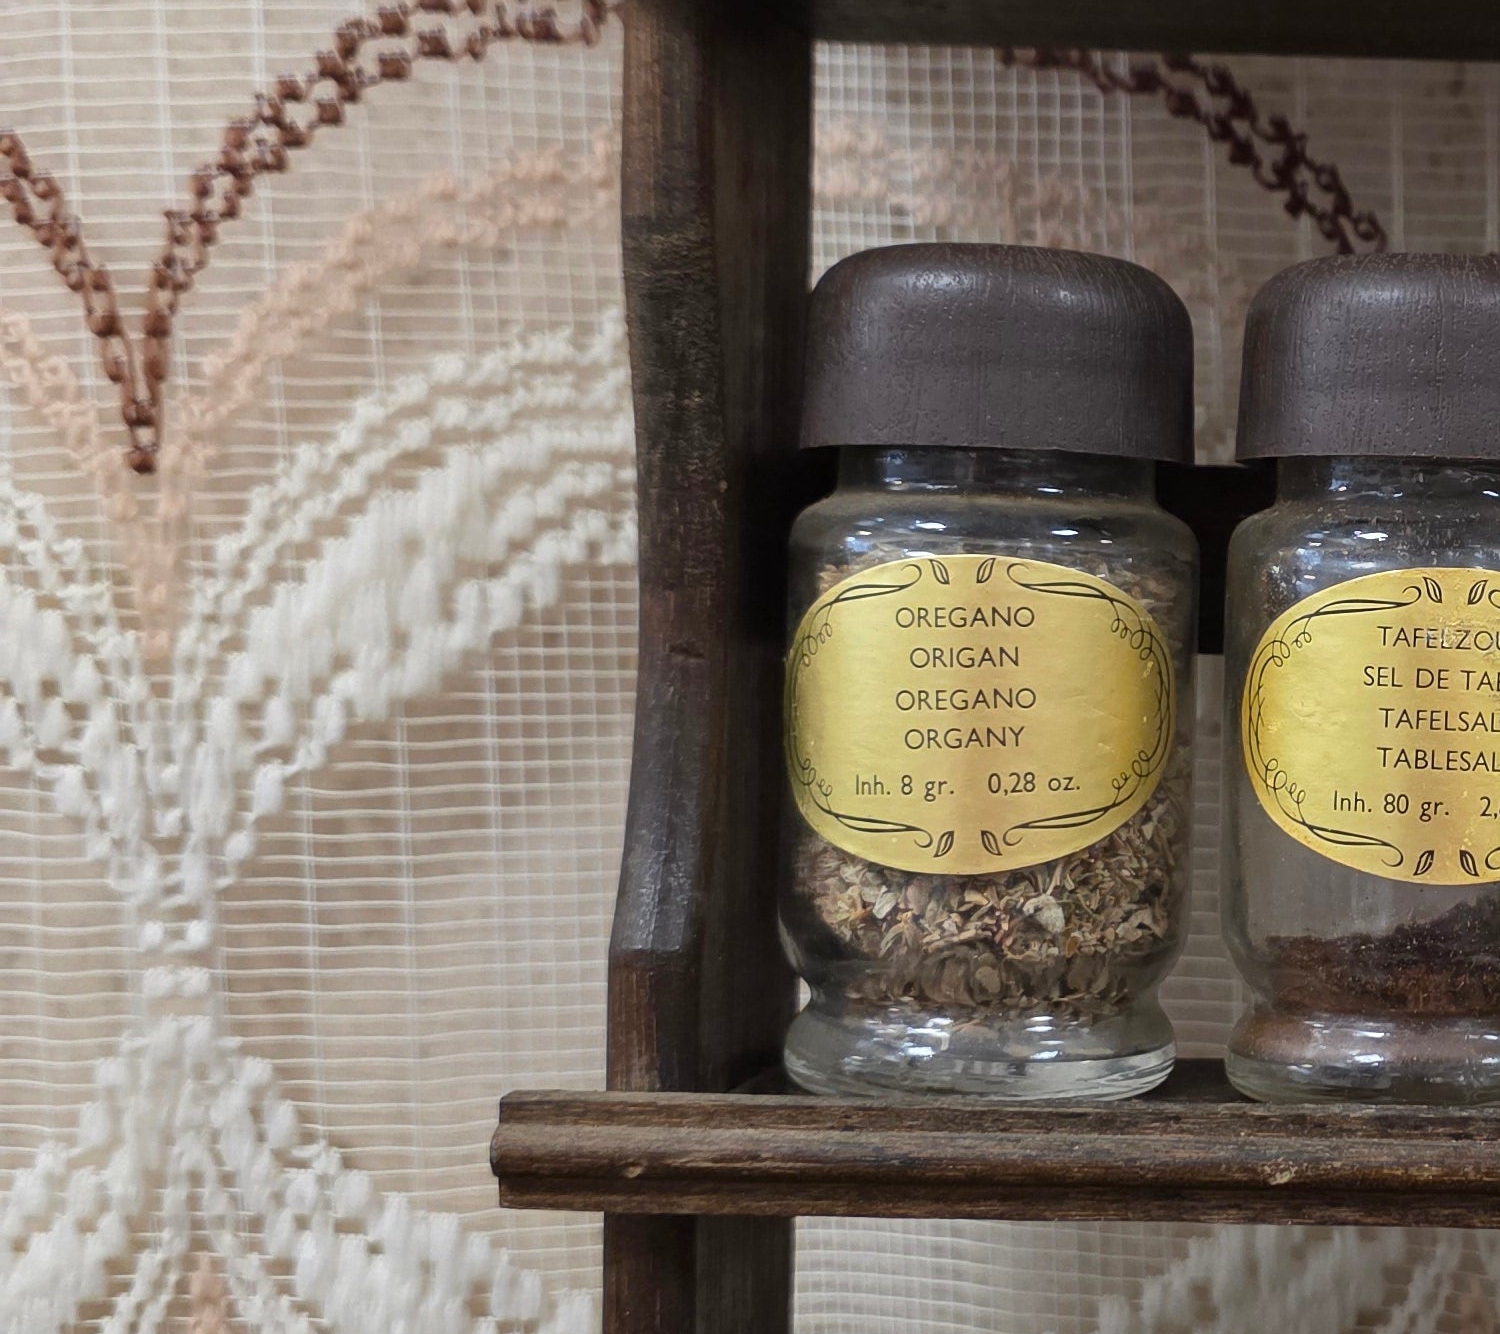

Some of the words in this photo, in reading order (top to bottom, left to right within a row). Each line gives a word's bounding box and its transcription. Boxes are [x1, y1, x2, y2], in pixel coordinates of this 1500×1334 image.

[895, 606, 1035, 628] OREGANO
[909, 646, 1020, 668] ORIGAN
[1363, 666, 1402, 688] SEL
[1415, 668, 1449, 689] DE
[895, 687, 1037, 711] OREGANO
[904, 727, 1025, 749] ORGANY
[855, 774, 890, 796] Inh.
[901, 774, 913, 795] 8
[924, 778, 954, 801] gr.
[988, 772, 1036, 796] 0,28
[1048, 774, 1080, 792] oz.
[1333, 791, 1372, 813] Inh.
[1383, 794, 1409, 815] 80
[1420, 798, 1449, 821] gr.
